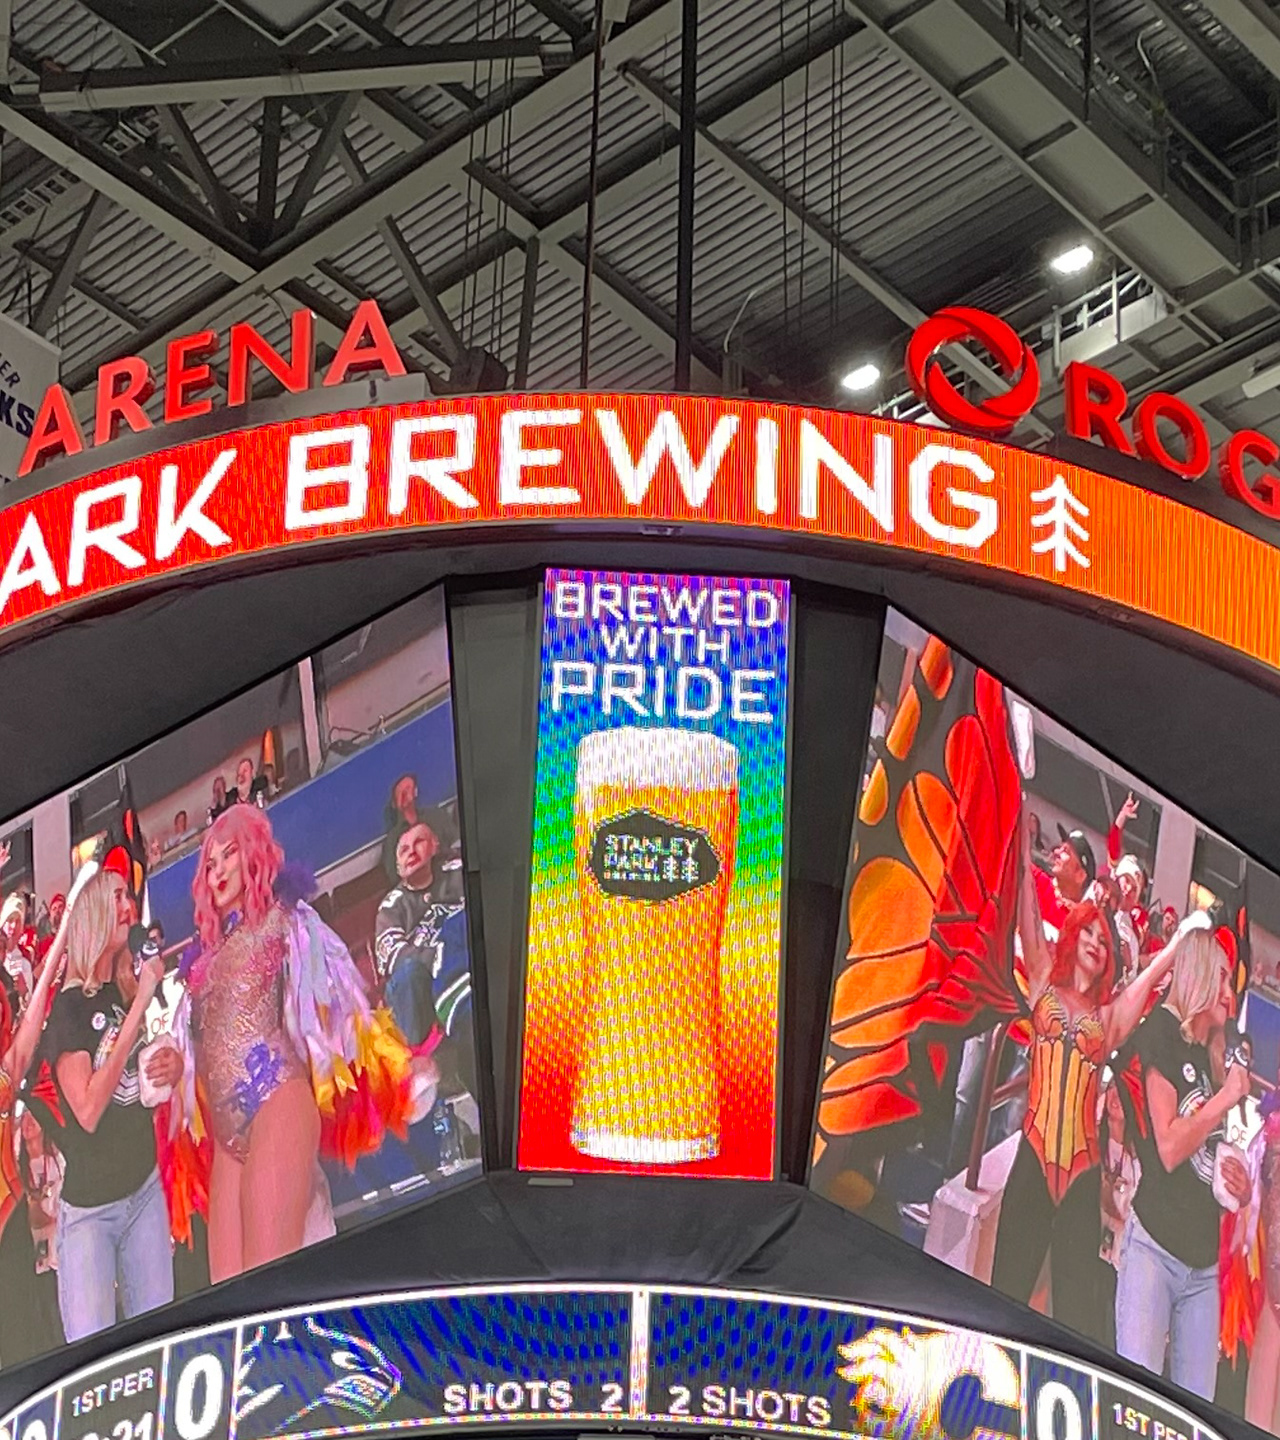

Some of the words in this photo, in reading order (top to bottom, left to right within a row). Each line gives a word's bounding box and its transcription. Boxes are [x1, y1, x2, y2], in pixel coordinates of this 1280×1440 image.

[18, 299, 408, 477] ARENA
[284, 408, 1001, 551] BREWING
[553, 582, 778, 628] BREWED
[600, 623, 731, 664] WITH
[552, 660, 776, 723] PRIDE
[72, 1385, 109, 1419] 1ST
[111, 1366, 156, 1405] PER
[442, 1379, 572, 1416] SHOTS
[601, 1381, 624, 1413] 2
[668, 1384, 691, 1415] 2
[701, 1384, 832, 1428] SHOTS
[1112, 1401, 1152, 1434] 1ST
